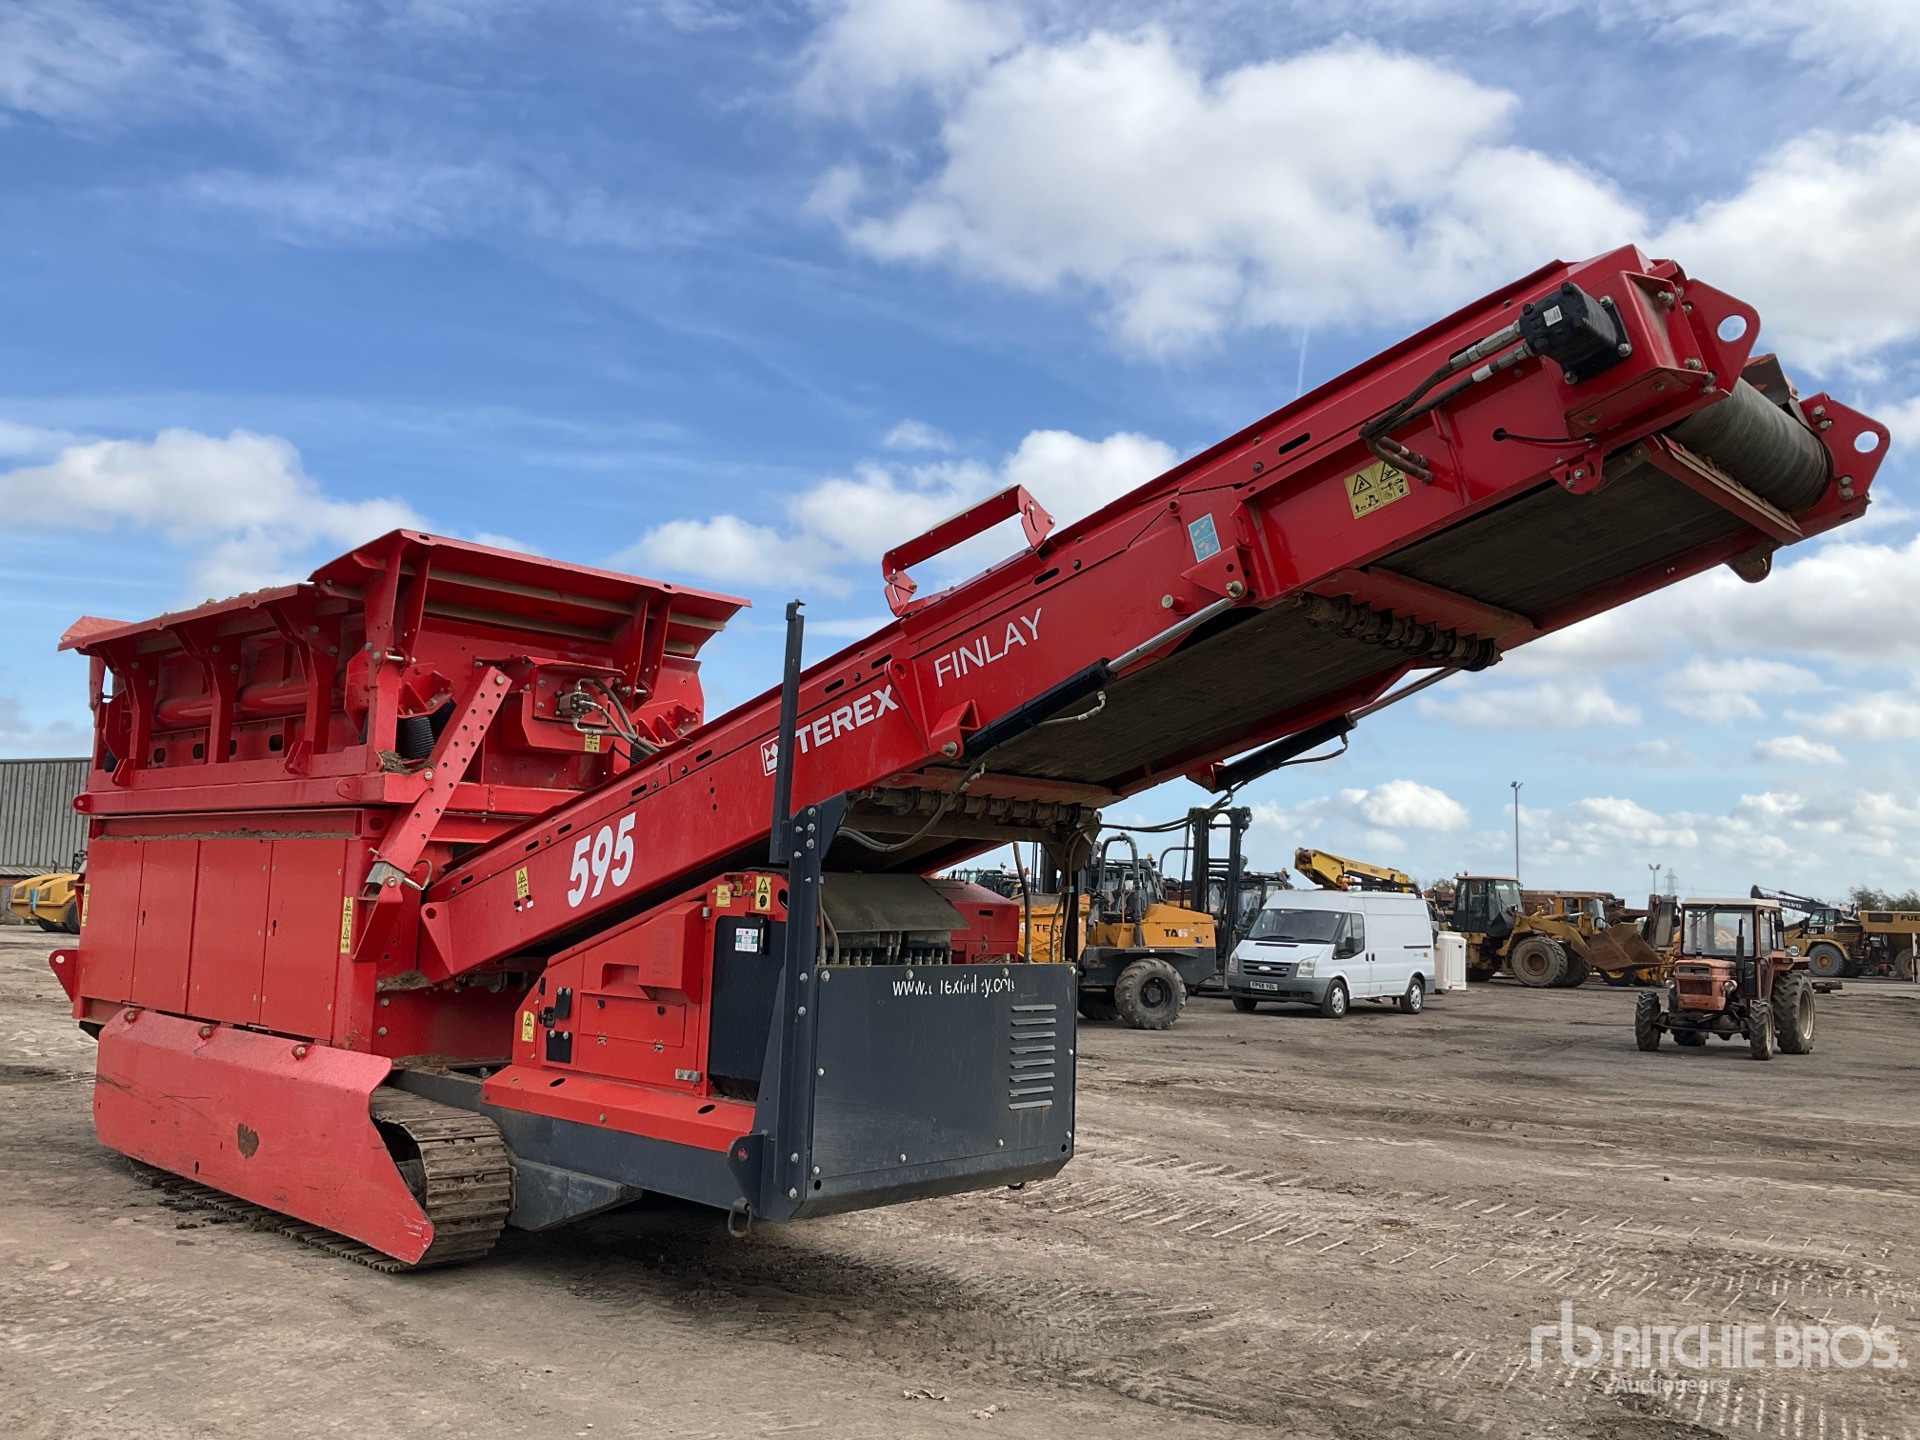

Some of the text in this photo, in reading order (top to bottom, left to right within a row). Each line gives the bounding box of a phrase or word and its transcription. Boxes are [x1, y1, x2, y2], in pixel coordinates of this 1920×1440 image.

[795, 607, 1042, 754] TEREX FINLAY
[567, 811, 636, 908] 595
